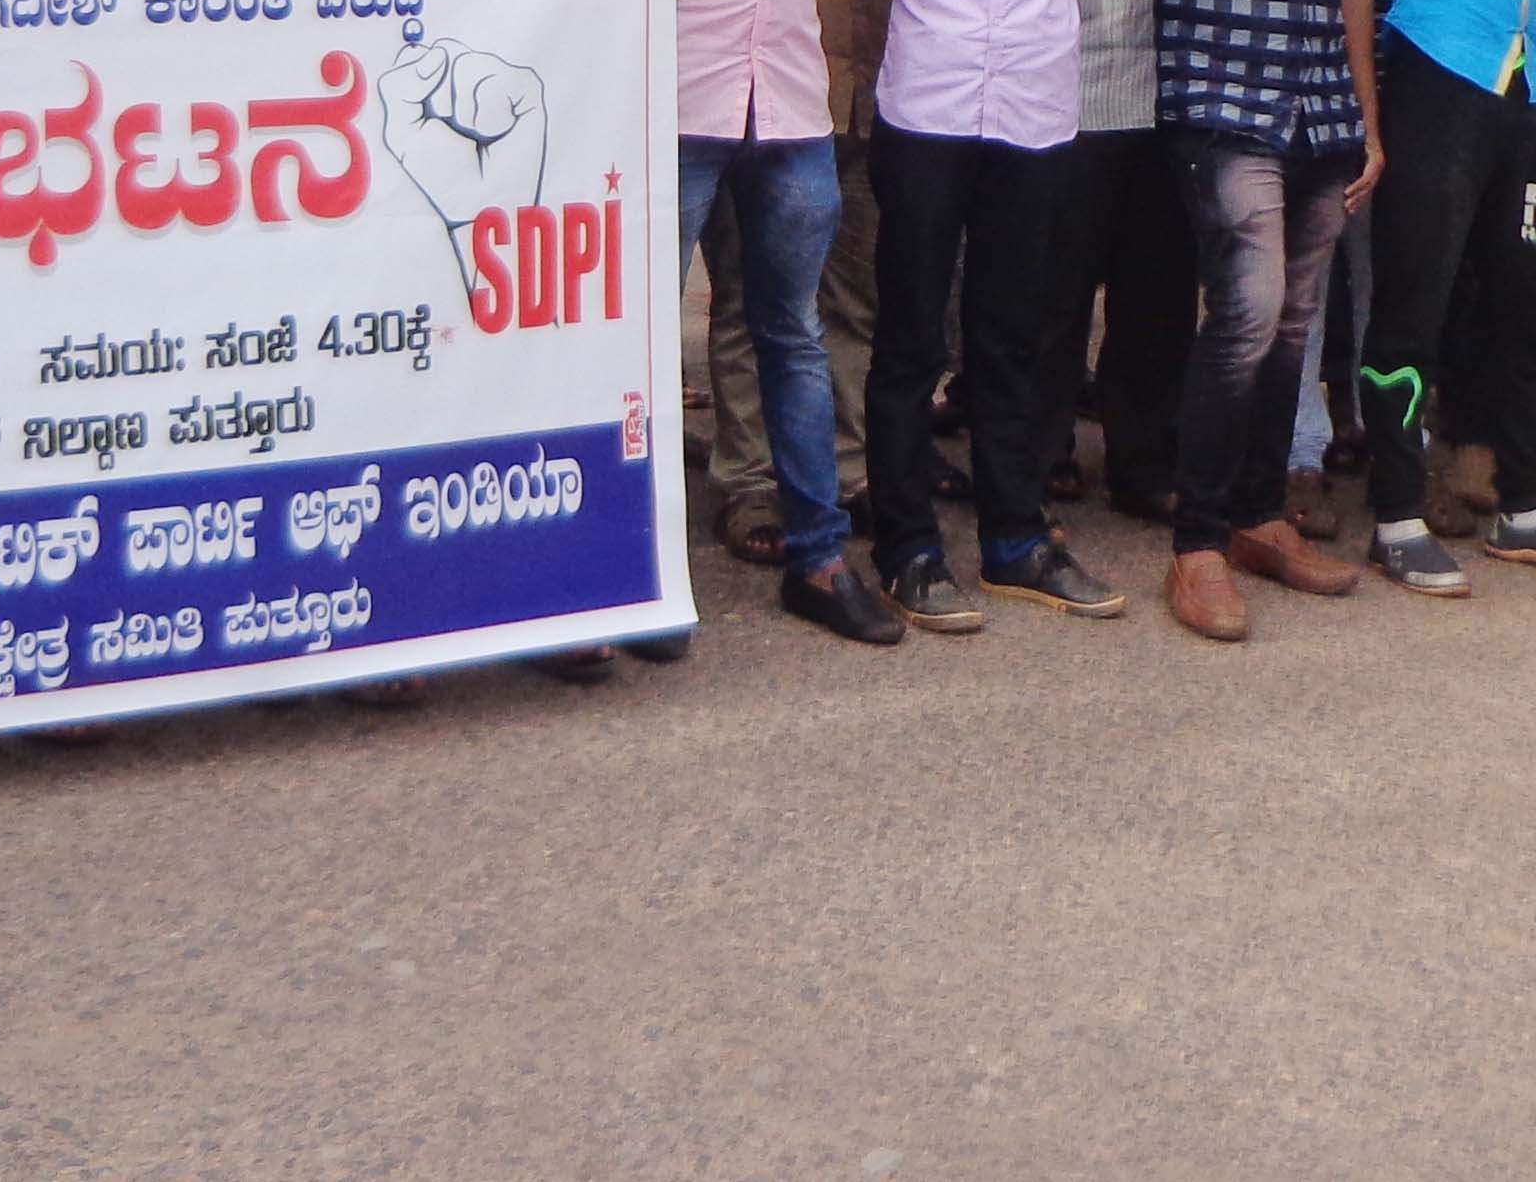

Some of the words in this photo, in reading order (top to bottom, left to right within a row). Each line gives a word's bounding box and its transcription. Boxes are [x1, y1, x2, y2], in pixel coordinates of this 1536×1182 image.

[470, 163, 624, 335] SDPI
[40, 327, 186, 386] ಸಮಯ:
[205, 313, 298, 370] ಸಂಜೆ
[316, 302, 433, 373] 4.30ಕ್ಕೆ
[22, 409, 150, 472] ನಿಲ್ದಾಣ
[168, 384, 317, 456] ಪುತ್ತೂರು
[126, 496, 265, 574] ಪಾರ್ಟಿ
[289, 463, 383, 561] ಆಫ್
[404, 441, 584, 540] ಇಂಡಿಯಾ
[91, 605, 206, 666] ಸಮಿತಿ
[223, 575, 373, 654] ಪುತ್ತೂರು
